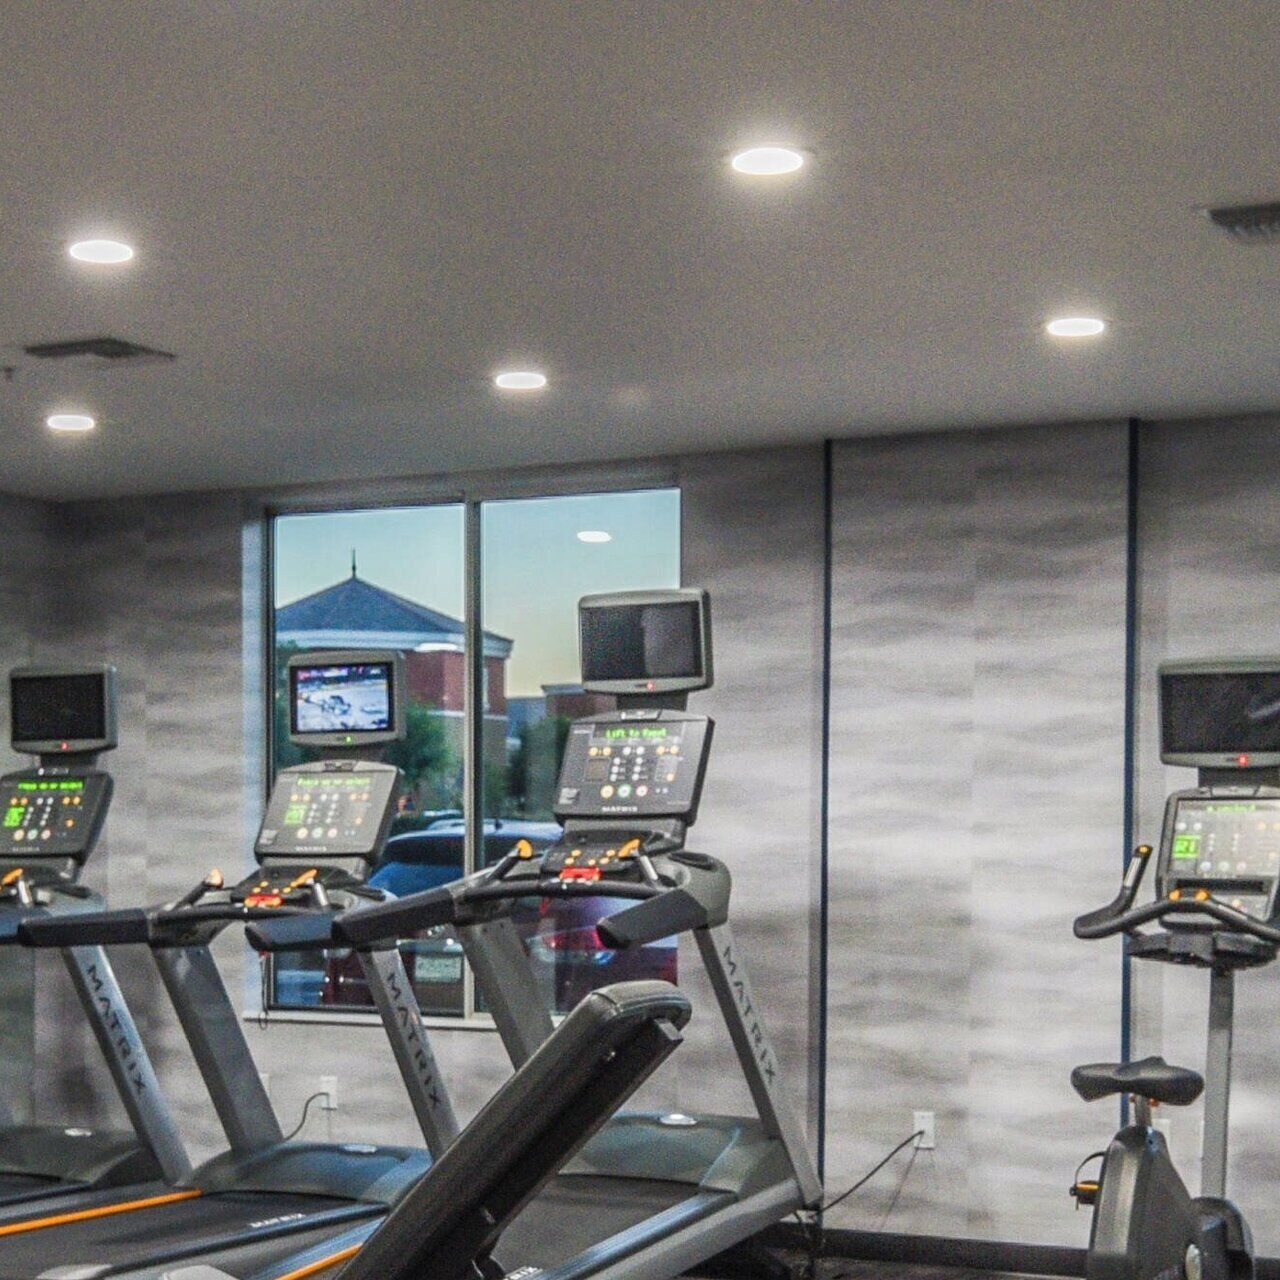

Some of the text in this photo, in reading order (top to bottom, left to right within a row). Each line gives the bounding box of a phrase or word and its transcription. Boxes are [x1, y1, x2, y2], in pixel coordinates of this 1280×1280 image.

[87, 964, 146, 1096] MATRIX
[387, 972, 441, 1107] MATRIX
[723, 946, 776, 1086] MATRIX
